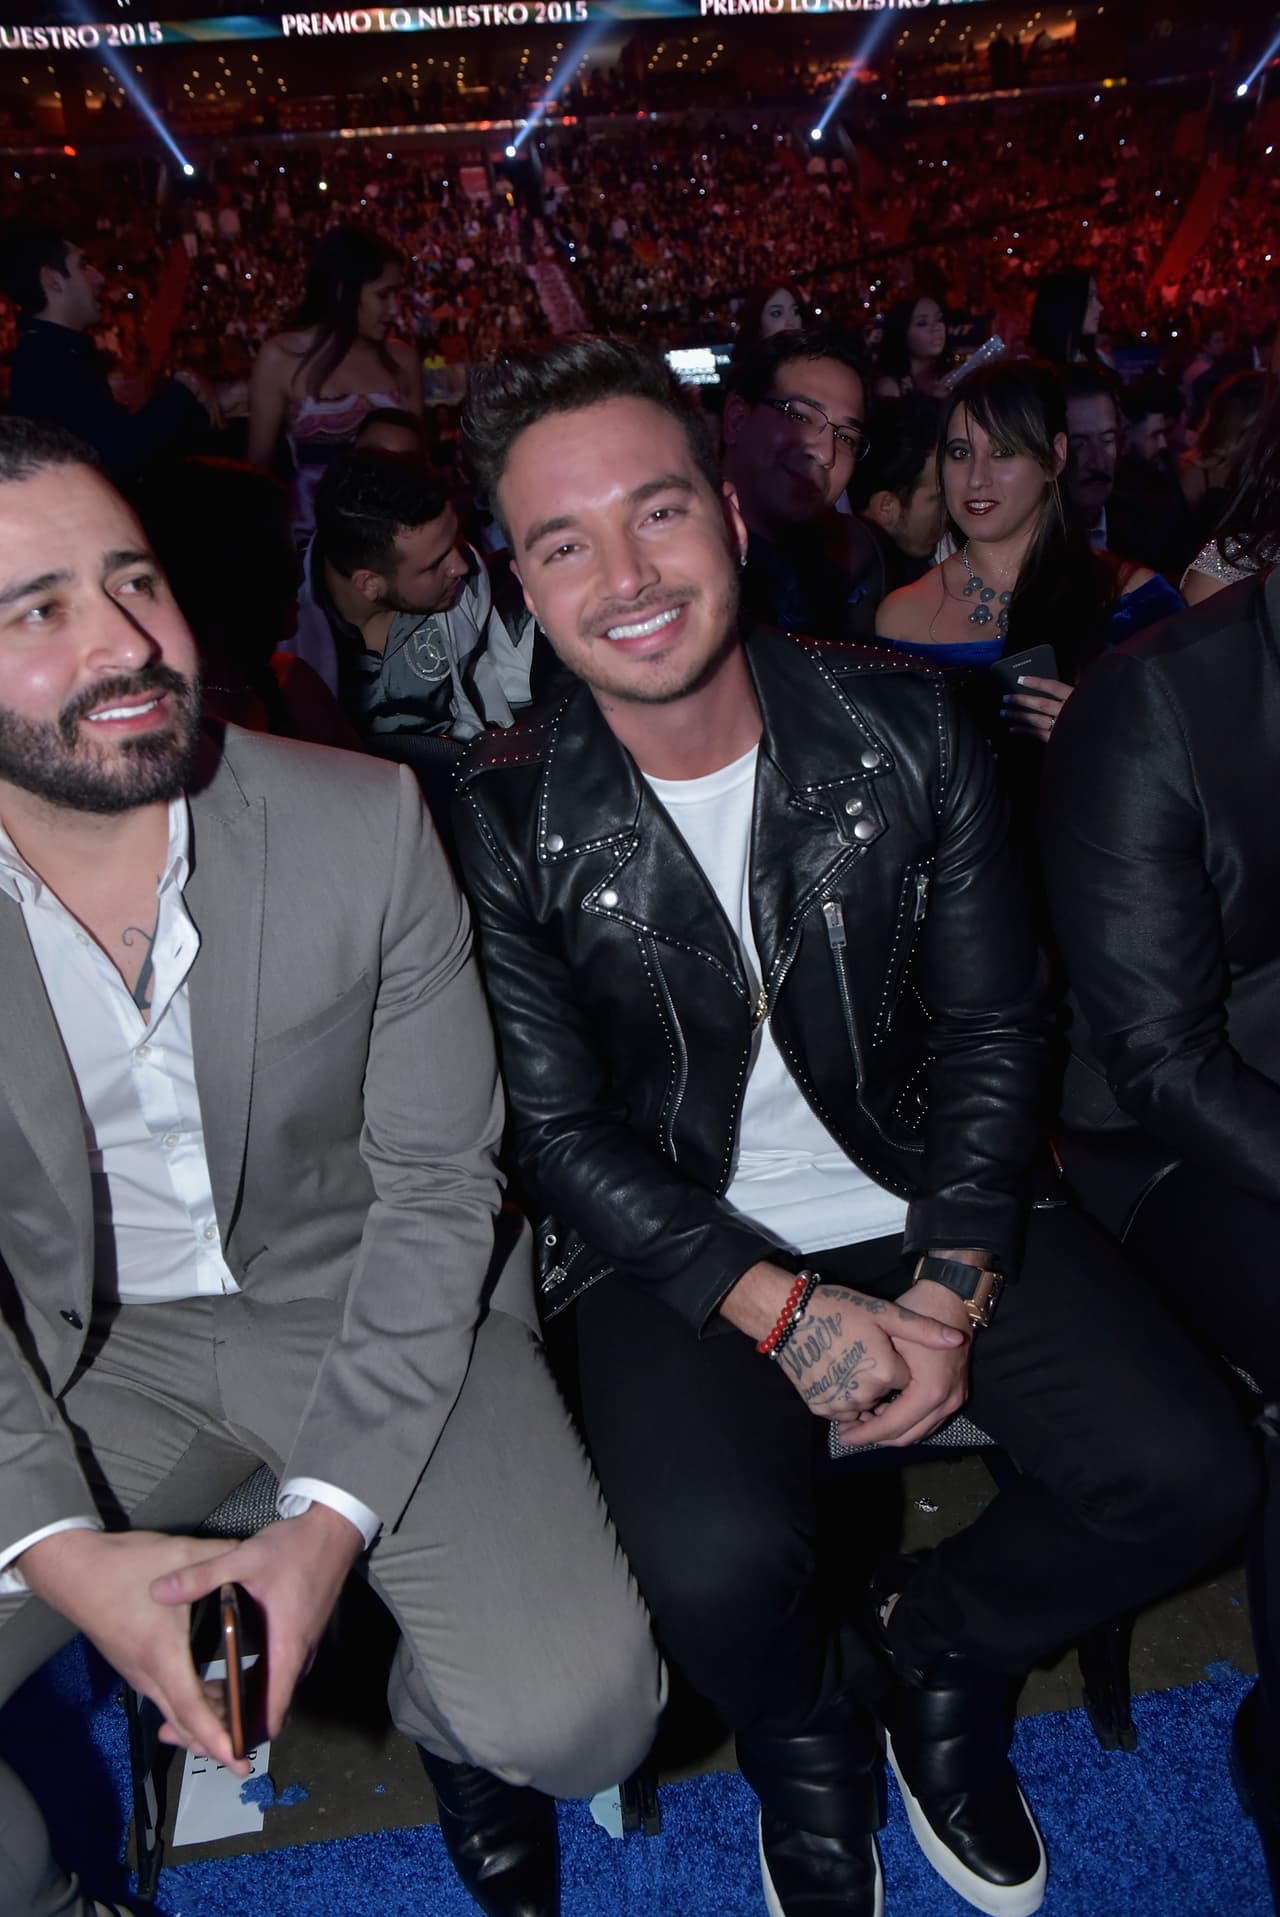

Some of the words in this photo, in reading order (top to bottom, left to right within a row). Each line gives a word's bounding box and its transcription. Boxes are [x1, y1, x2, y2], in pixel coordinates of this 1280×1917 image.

[281, 9, 371, 37] PREMIO
[377, 6, 412, 32] LO
[418, 3, 528, 28] NUESTRO
[534, 1, 588, 24] 2015
[0, 24, 99, 50] UESTRO
[106, 21, 163, 46] 2015
